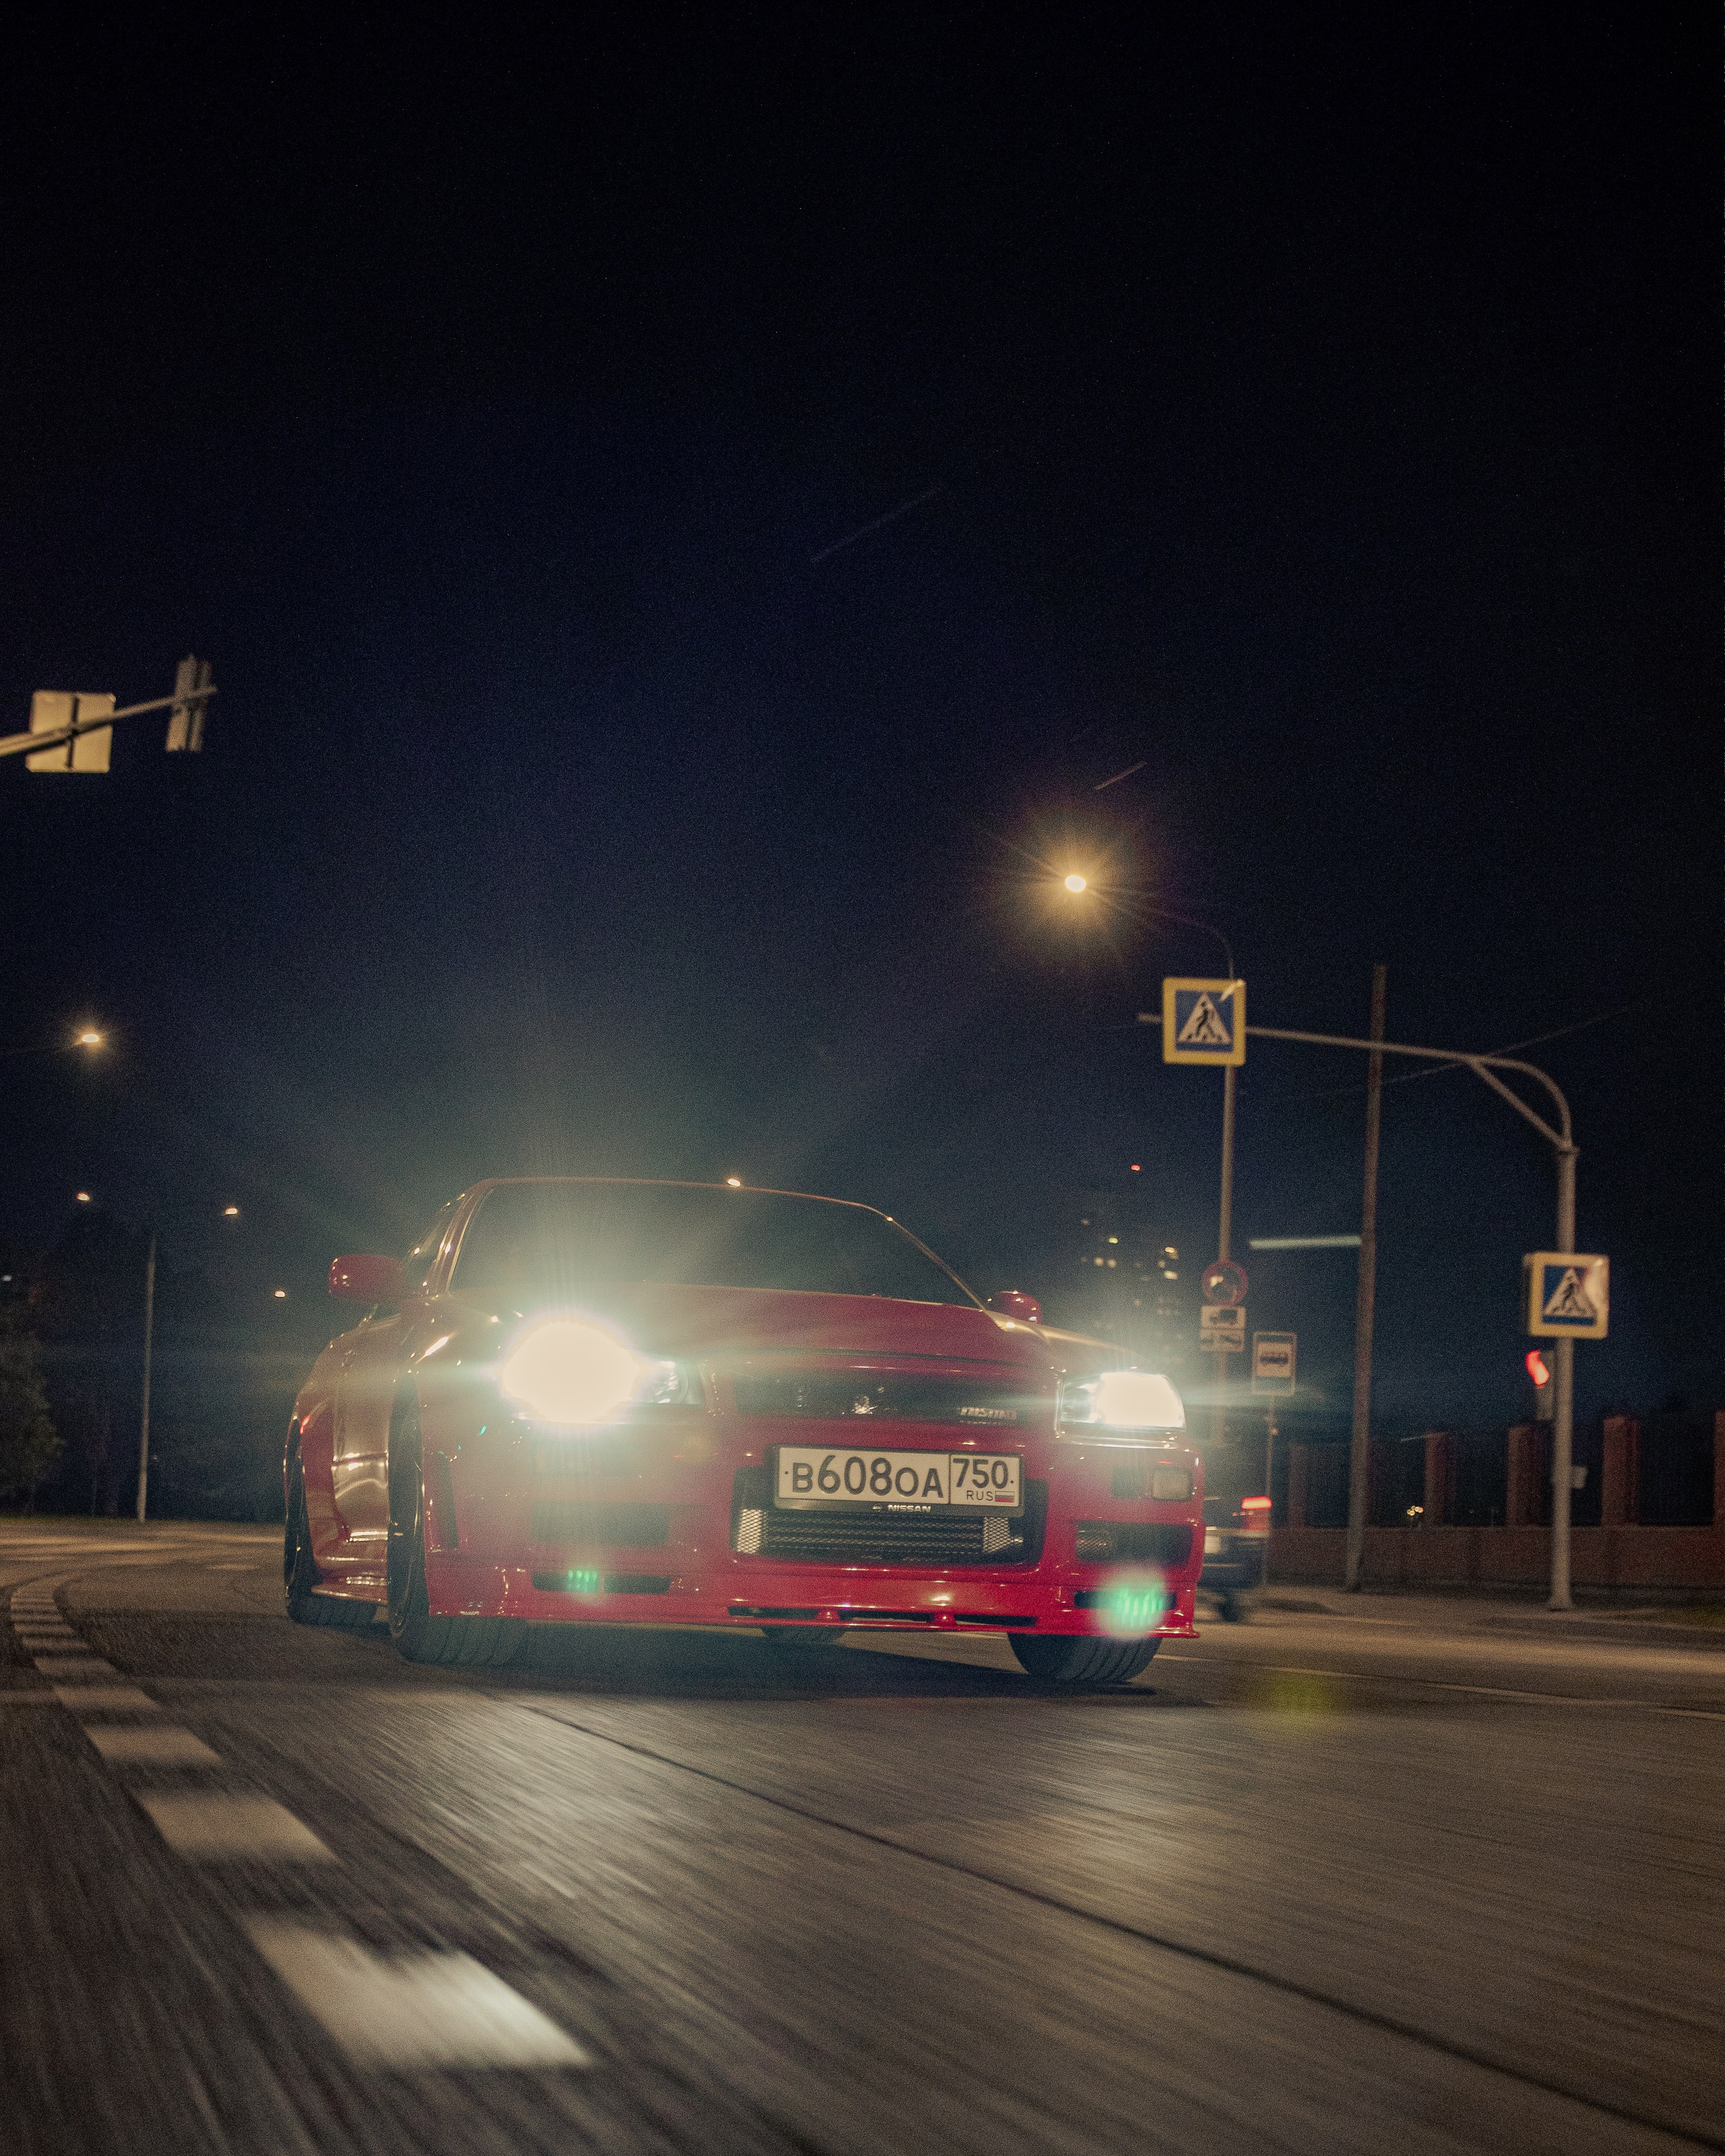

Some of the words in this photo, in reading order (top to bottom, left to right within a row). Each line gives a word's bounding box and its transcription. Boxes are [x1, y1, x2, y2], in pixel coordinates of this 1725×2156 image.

[952, 1458, 1009, 1488] 750
[966, 1490, 994, 1502] RUS
[887, 1504, 931, 1514] NISSAN
